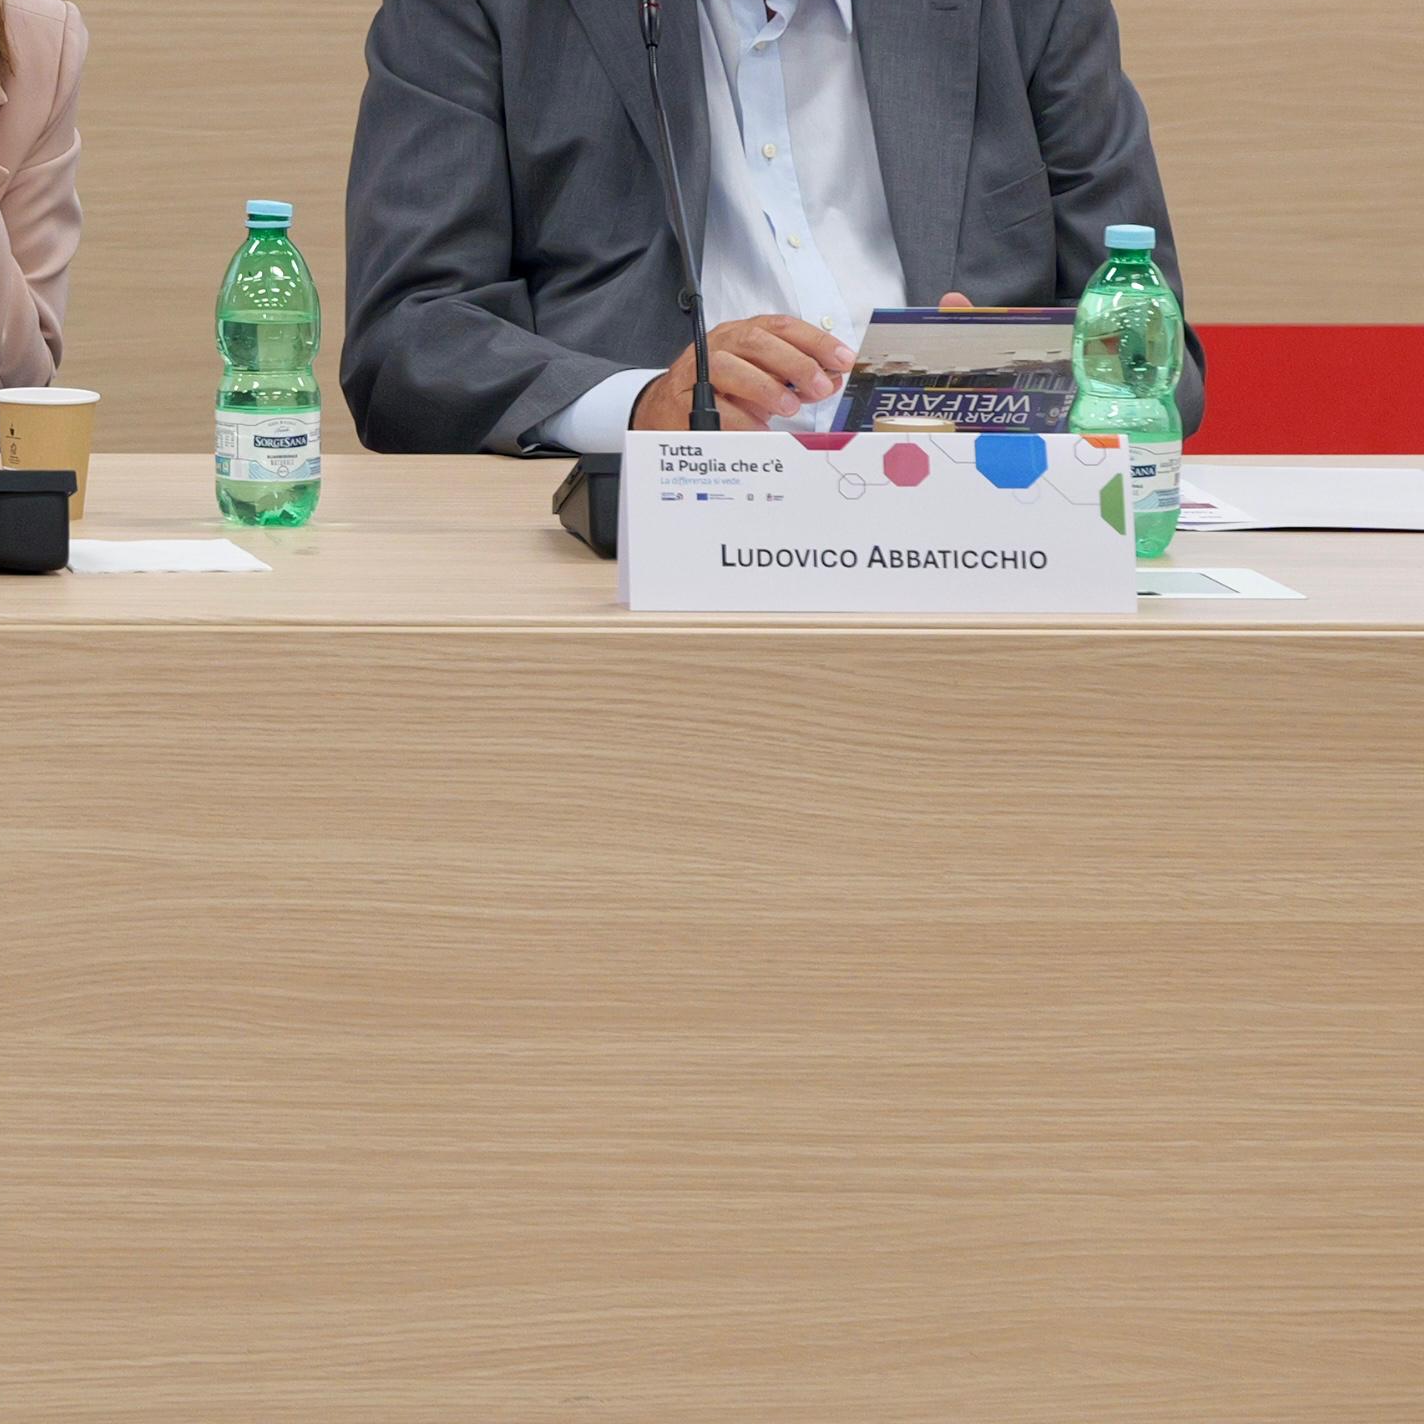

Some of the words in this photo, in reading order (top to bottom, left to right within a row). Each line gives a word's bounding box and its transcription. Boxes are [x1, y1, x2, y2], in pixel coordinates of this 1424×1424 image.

[876, 393, 1031, 412] WELFARE
[255, 435, 307, 448] SORGESANA
[659, 444, 703, 456] Tutta
[660, 459, 673, 471] la
[679, 459, 726, 475] Puglia
[731, 459, 758, 472] che
[660, 477, 670, 485] La
[719, 543, 858, 569] LUDOVICO
[866, 544, 1048, 570] ABBATICCHIO
